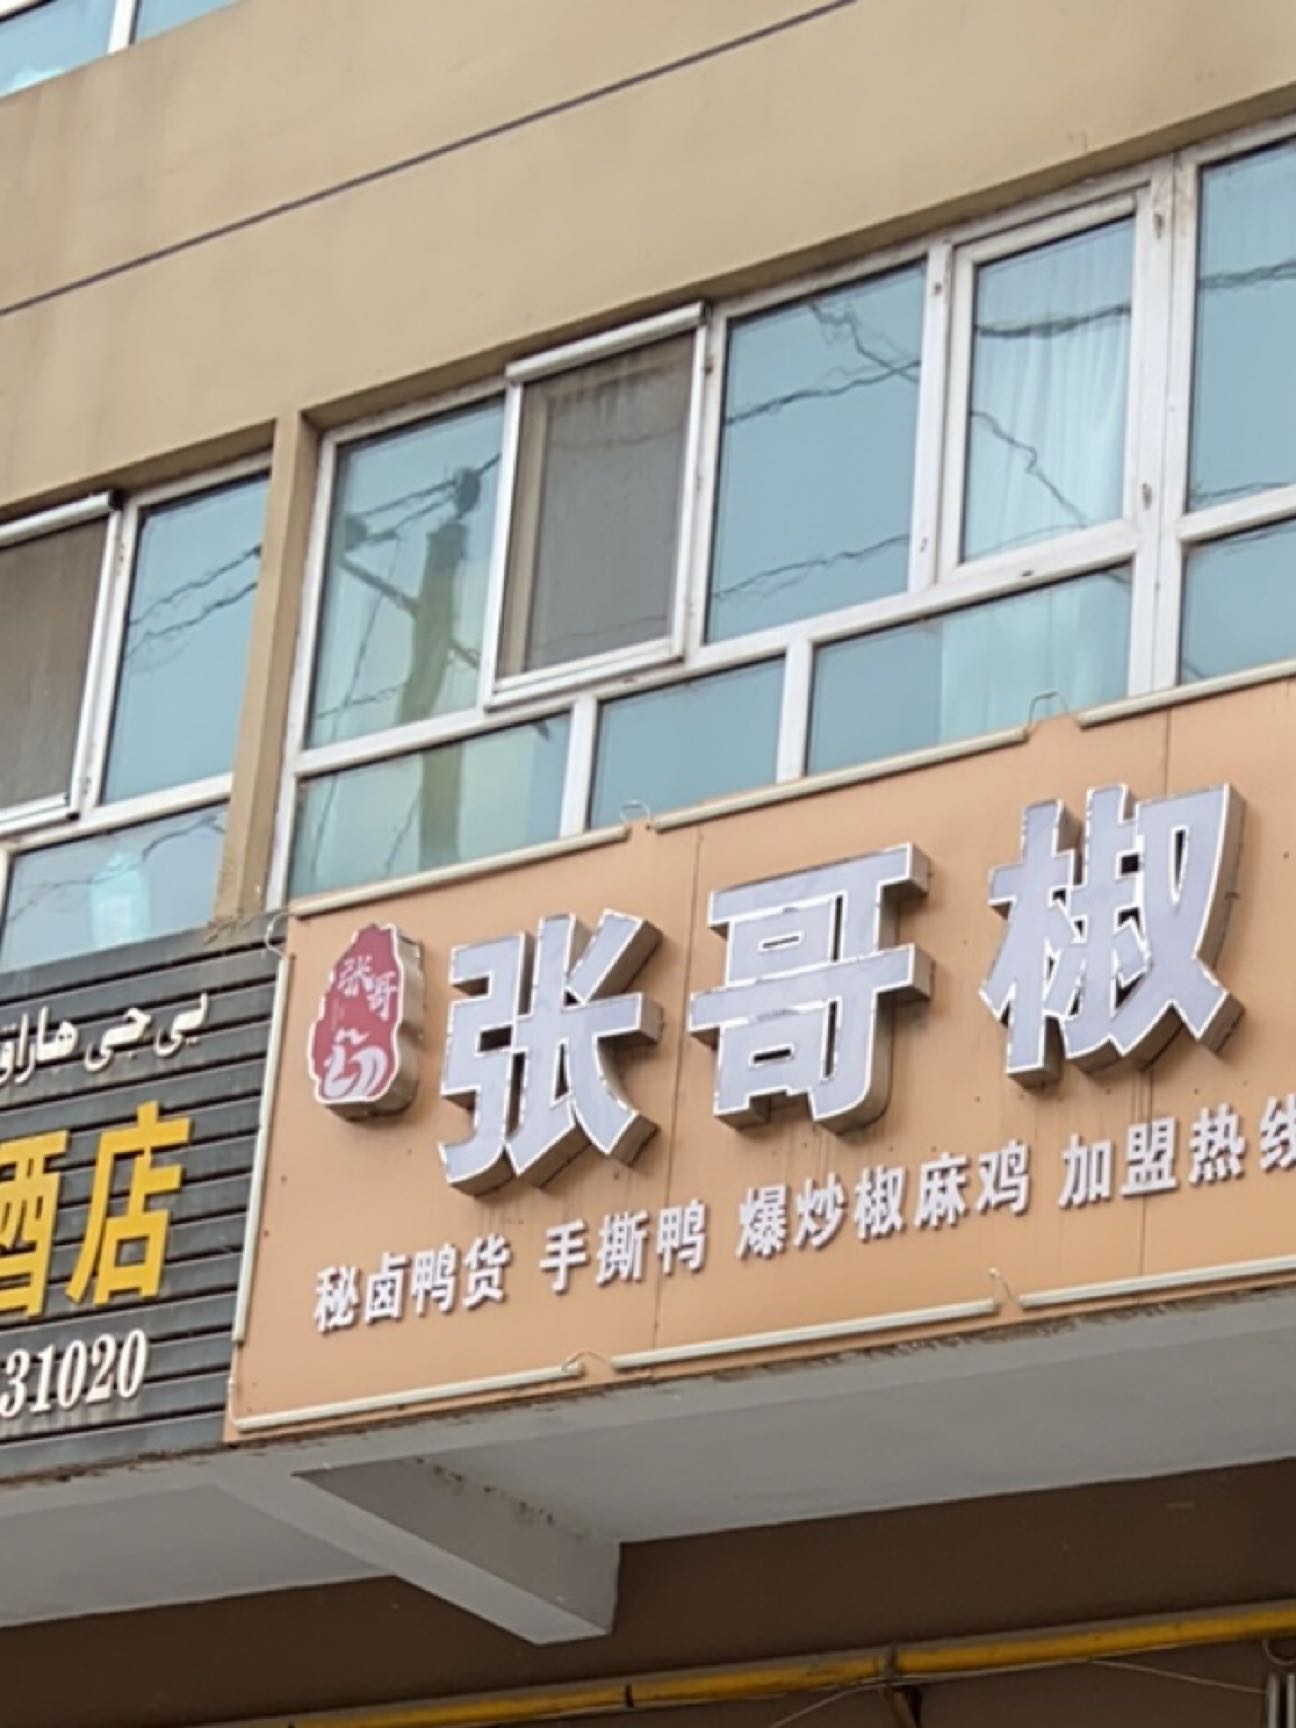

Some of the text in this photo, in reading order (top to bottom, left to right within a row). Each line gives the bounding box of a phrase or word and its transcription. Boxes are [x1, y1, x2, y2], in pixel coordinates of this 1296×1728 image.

[313, 1235, 512, 1334] 秘卤鸭货
[538, 1200, 707, 1294] 手撕鸭
[735, 1141, 1031, 1260] 爆炒椒麻鸡
[0, 1329, 149, 1419] 31020
